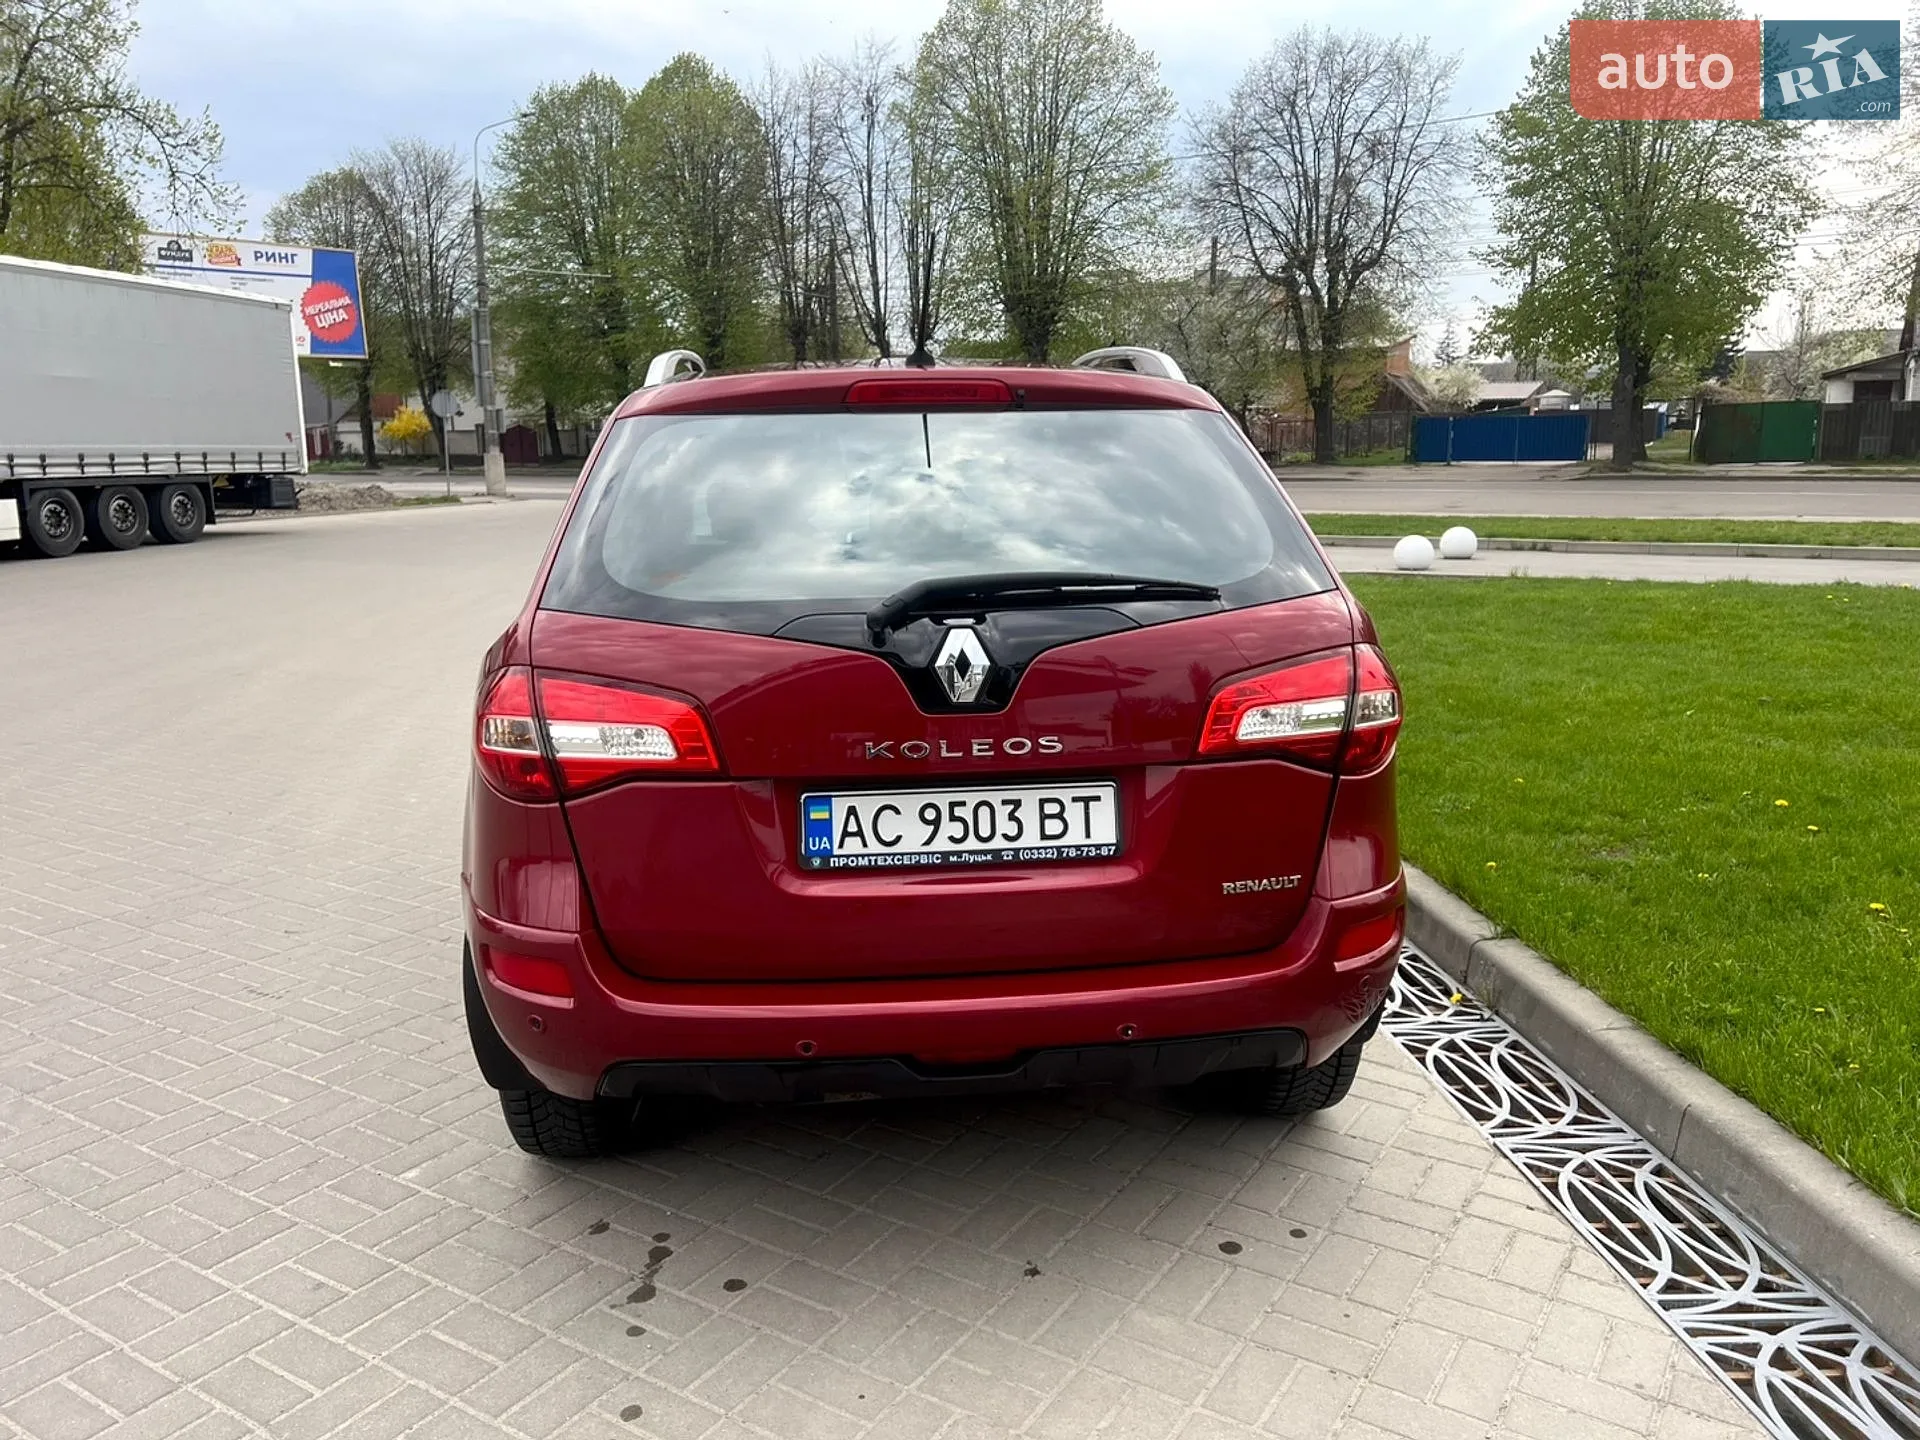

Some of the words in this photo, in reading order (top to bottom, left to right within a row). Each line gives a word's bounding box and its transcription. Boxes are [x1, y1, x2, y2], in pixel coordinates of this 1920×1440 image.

[254, 250, 298, 264] РИНГ
[304, 295, 352, 316] НЕРЕАЛЬНА
[314, 309, 349, 328] ЦІНА
[865, 736, 1064, 760] KOLEOS
[837, 803, 903, 850] AC
[917, 797, 1024, 847] 9503
[1039, 795, 1102, 841] BT
[809, 837, 831, 851] UA
[829, 853, 942, 868] ПРОМТЕХСЕРВІС
[1019, 847, 1058, 861] (0332)
[1222, 874, 1302, 895] RENAULT
